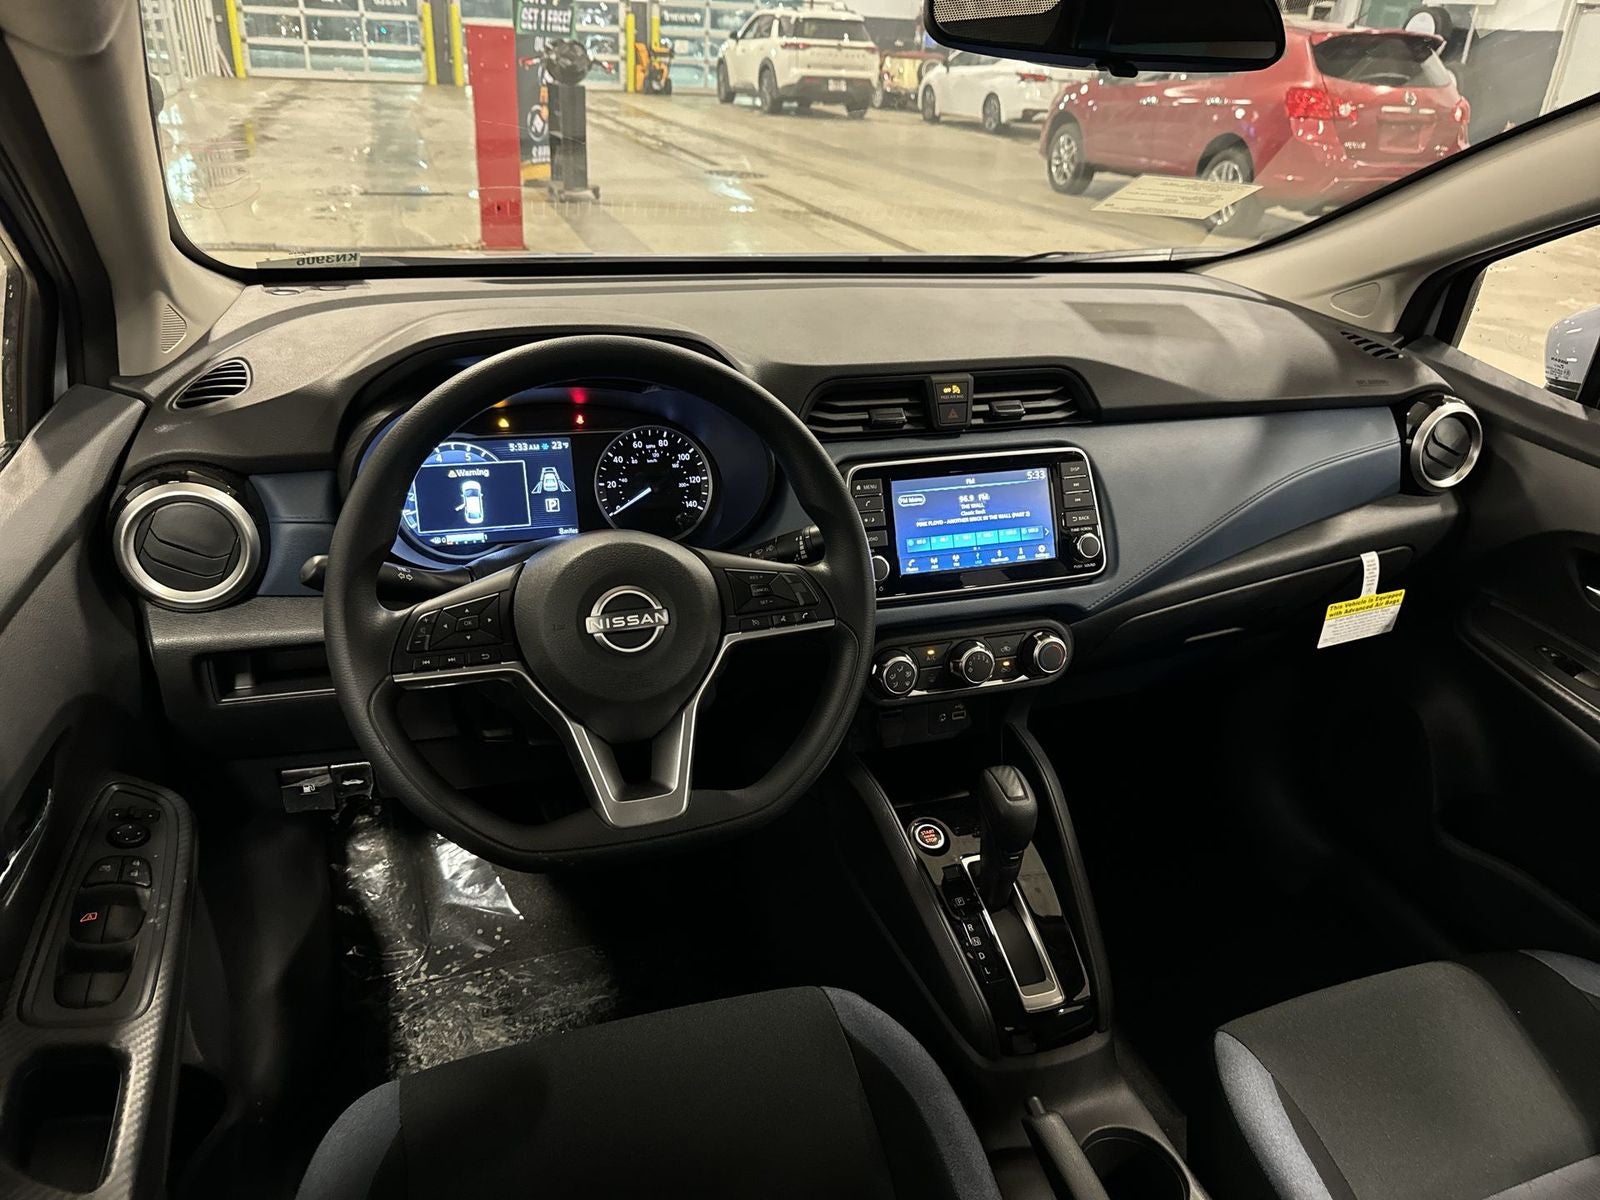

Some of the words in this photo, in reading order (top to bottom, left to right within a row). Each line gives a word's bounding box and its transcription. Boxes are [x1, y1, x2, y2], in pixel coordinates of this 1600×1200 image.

[508, 442, 528, 452] 5:33
[632, 440, 643, 449] 60
[658, 439, 669, 447] 80
[436, 453, 442, 463] 4
[465, 452, 471, 461] 5
[677, 453, 690, 461] 100
[457, 468, 490, 478] Warning
[1026, 470, 1046, 480] 5:33
[688, 475, 701, 484] 120
[606, 481, 617, 489] 20
[685, 500, 698, 508] 140
[1344, 599, 1367, 608] Vehicle
[1375, 591, 1403, 602] Equipped
[1328, 610, 1343, 618] with
[1343, 603, 1374, 615] Advanced
[1374, 600, 1384, 608] Air
[1384, 598, 1400, 606] Bags
[588, 611, 667, 630] NISSAN
[967, 923, 974, 932] R
[978, 951, 986, 960] D
[984, 967, 991, 975] L
